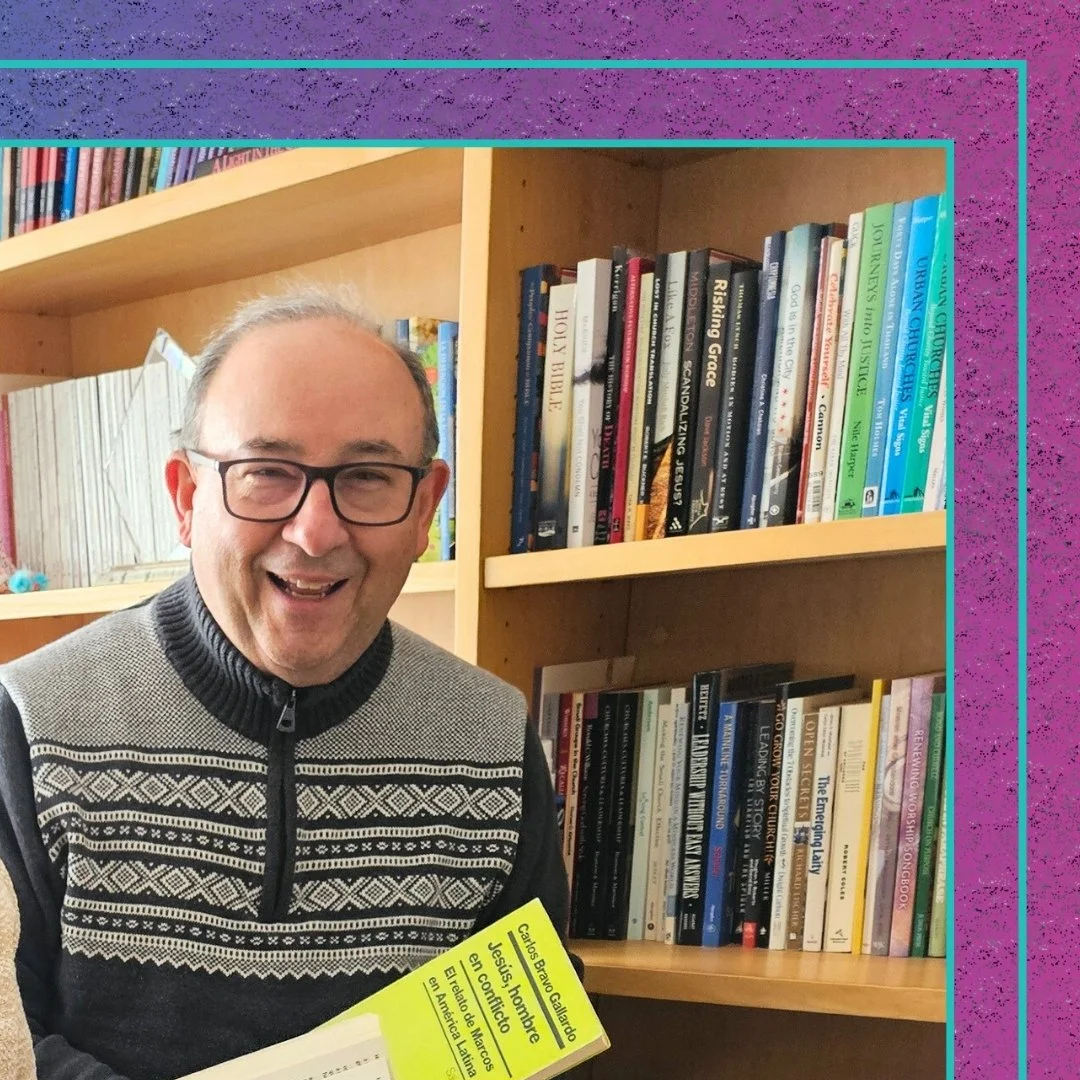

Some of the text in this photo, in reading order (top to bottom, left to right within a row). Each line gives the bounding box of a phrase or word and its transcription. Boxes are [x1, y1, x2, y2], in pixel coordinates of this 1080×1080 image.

[891, 250, 902, 277] DAYS
[610, 264, 623, 313] Kerrigan
[654, 302, 659, 311] IN
[707, 280, 727, 337] Risking
[736, 284, 745, 320] THOMAS
[825, 272, 839, 334] Celebrate
[887, 278, 898, 309] ALONE
[662, 280, 679, 351] Like A Fox
[733, 322, 741, 350] LYNCH
[782, 284, 801, 380] God is in the City
[548, 309, 569, 412] HOLY BIBLE
[820, 336, 833, 388] Yourself
[837, 309, 851, 380] With All Thy Mind
[845, 223, 885, 479] JOURNEYS into JUSTICE Nile Harper
[880, 322, 893, 370] THAILAND
[893, 255, 929, 457] URBAN CHURCHES Vital Signs
[926, 311, 947, 399] CHURCHES
[647, 350, 655, 405] TRANSLATION
[706, 344, 722, 388] Grace
[730, 357, 738, 393] BODIES
[606, 374, 614, 409] HISTORY
[673, 272, 699, 505] MIDDLETON SCANDALIZING JESUS?
[728, 396, 735, 407] IN
[604, 411, 612, 422] OF
[724, 411, 733, 448] MOTION
[814, 404, 827, 451] Cannon
[922, 404, 933, 427] Vital
[601, 424, 613, 469] DEATH
[701, 438, 710, 467] Jackson
[870, 421, 883, 457] HOLMES
[917, 429, 929, 454] Signs
[639, 464, 647, 496] BUCKNER
[718, 487, 726, 510] REST
[721, 473, 727, 483] AT
[698, 684, 709, 721] HEIFETZ
[774, 713, 784, 731] GO
[720, 723, 732, 766] MAINLINE
[787, 707, 799, 748] Overcoming
[689, 733, 709, 789] LEADERSHIP
[772, 734, 783, 767] GROW
[786, 749, 795, 759] the
[715, 770, 728, 830] TURNAROUND
[752, 725, 770, 840] LEADING BY STORY
[769, 772, 780, 802] YOUR
[783, 765, 793, 796] Obstacles
[817, 775, 830, 795] The
[686, 790, 706, 832] WITHOUT
[765, 804, 777, 853] CHURCH!
[791, 720, 815, 927] OPEN SECRETS RICHARD LISCHER
[810, 796, 828, 848] Emerging
[898, 729, 924, 911] RENEWING WORSHIP SONGBOOK
[685, 833, 703, 856] EASY
[780, 833, 788, 857] Growth
[809, 849, 824, 875] Laity
[682, 858, 701, 899] ANSWERS
[777, 871, 786, 893] Dwight
[469, 953, 511, 1033] en conflicto
[487, 940, 540, 1044] Jesús, hombre
[518, 923, 577, 1042] Carlos Bravo Gallardo
[429, 977, 477, 1078] en América Latina
[443, 967, 495, 1072] El relato de Marcos
